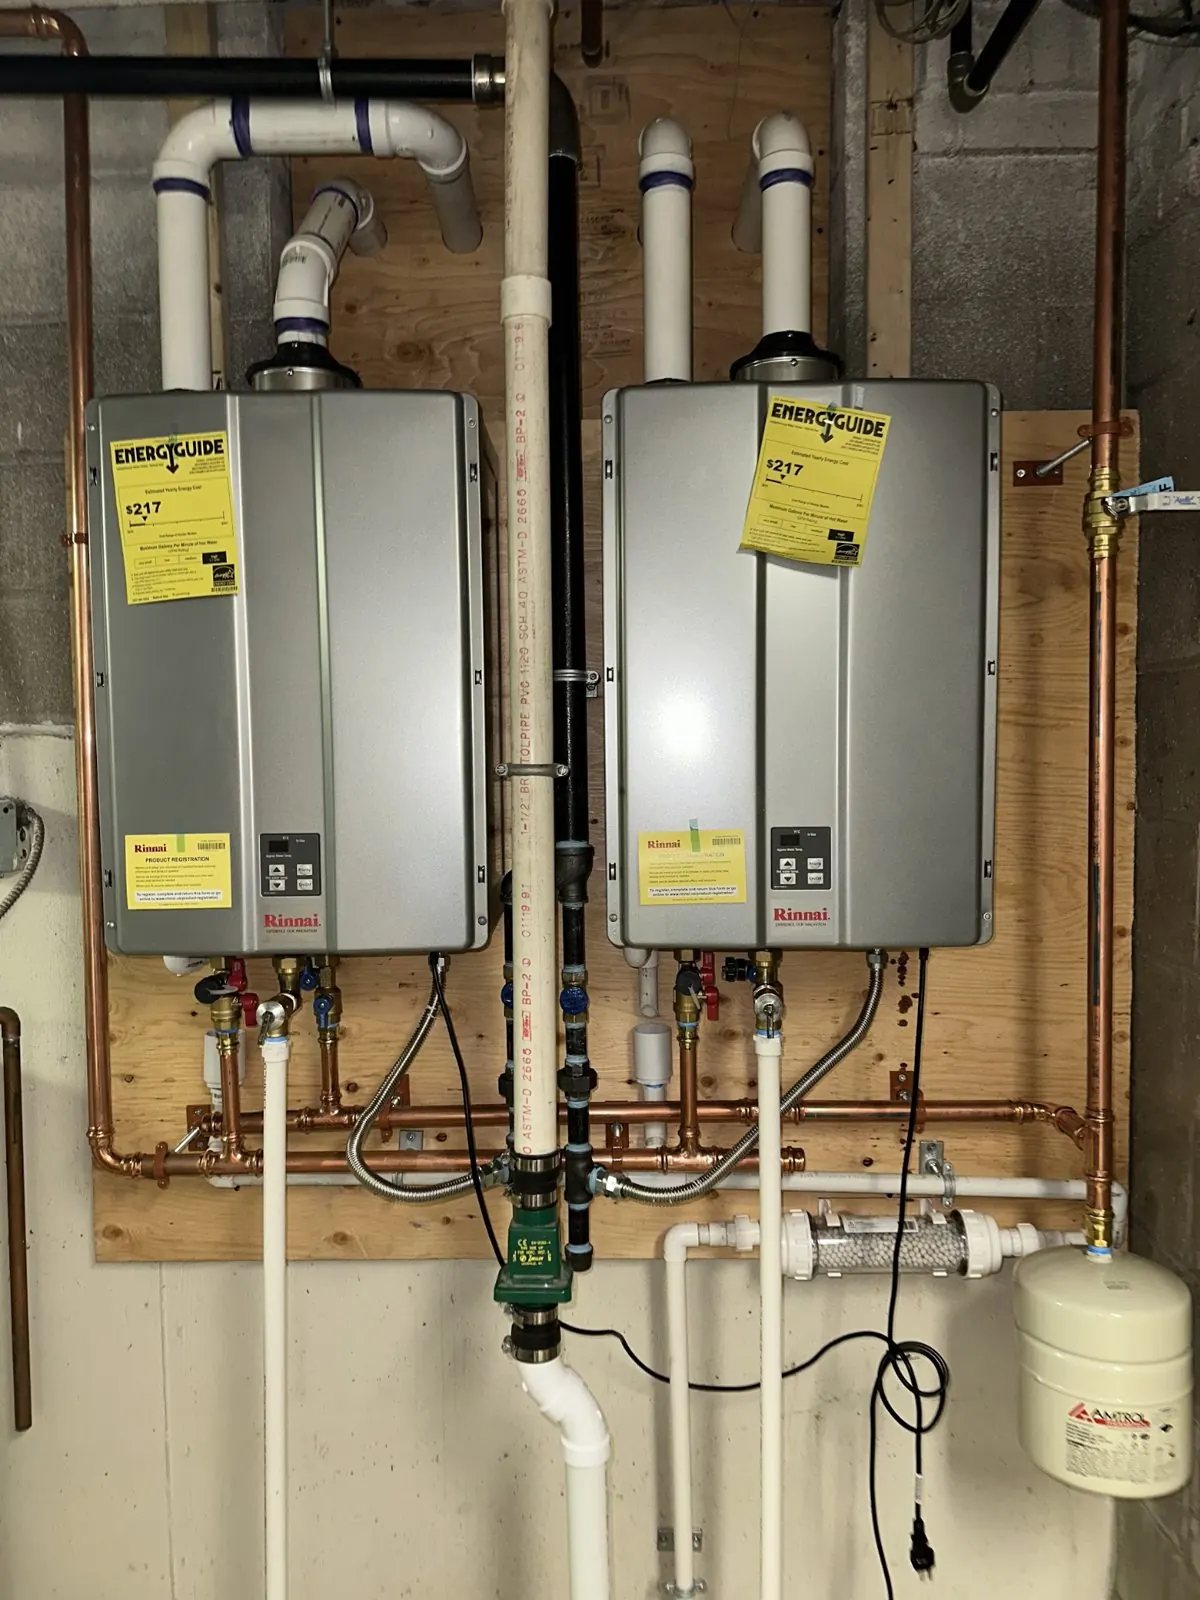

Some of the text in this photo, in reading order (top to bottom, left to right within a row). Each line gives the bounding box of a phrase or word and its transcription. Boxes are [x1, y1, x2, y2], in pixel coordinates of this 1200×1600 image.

[766, 459, 803, 476] $217
[126, 501, 161, 515] $217
[517, 489, 527, 523] 2665
[517, 532, 528, 583] ASTM-D
[518, 591, 528, 608] 40
[518, 616, 528, 640] SCH
[520, 681, 530, 705] PVC
[520, 712, 530, 793] BRTOLPIPE
[134, 844, 167, 853] Rinnai
[648, 840, 680, 849] Rinnai
[264, 914, 318, 927] Rinnai
[774, 908, 828, 920] Rinnai
[522, 974, 531, 1005] BP-2
[522, 1048, 531, 1081] 2665
[522, 1089, 532, 1139] ASTM-D
